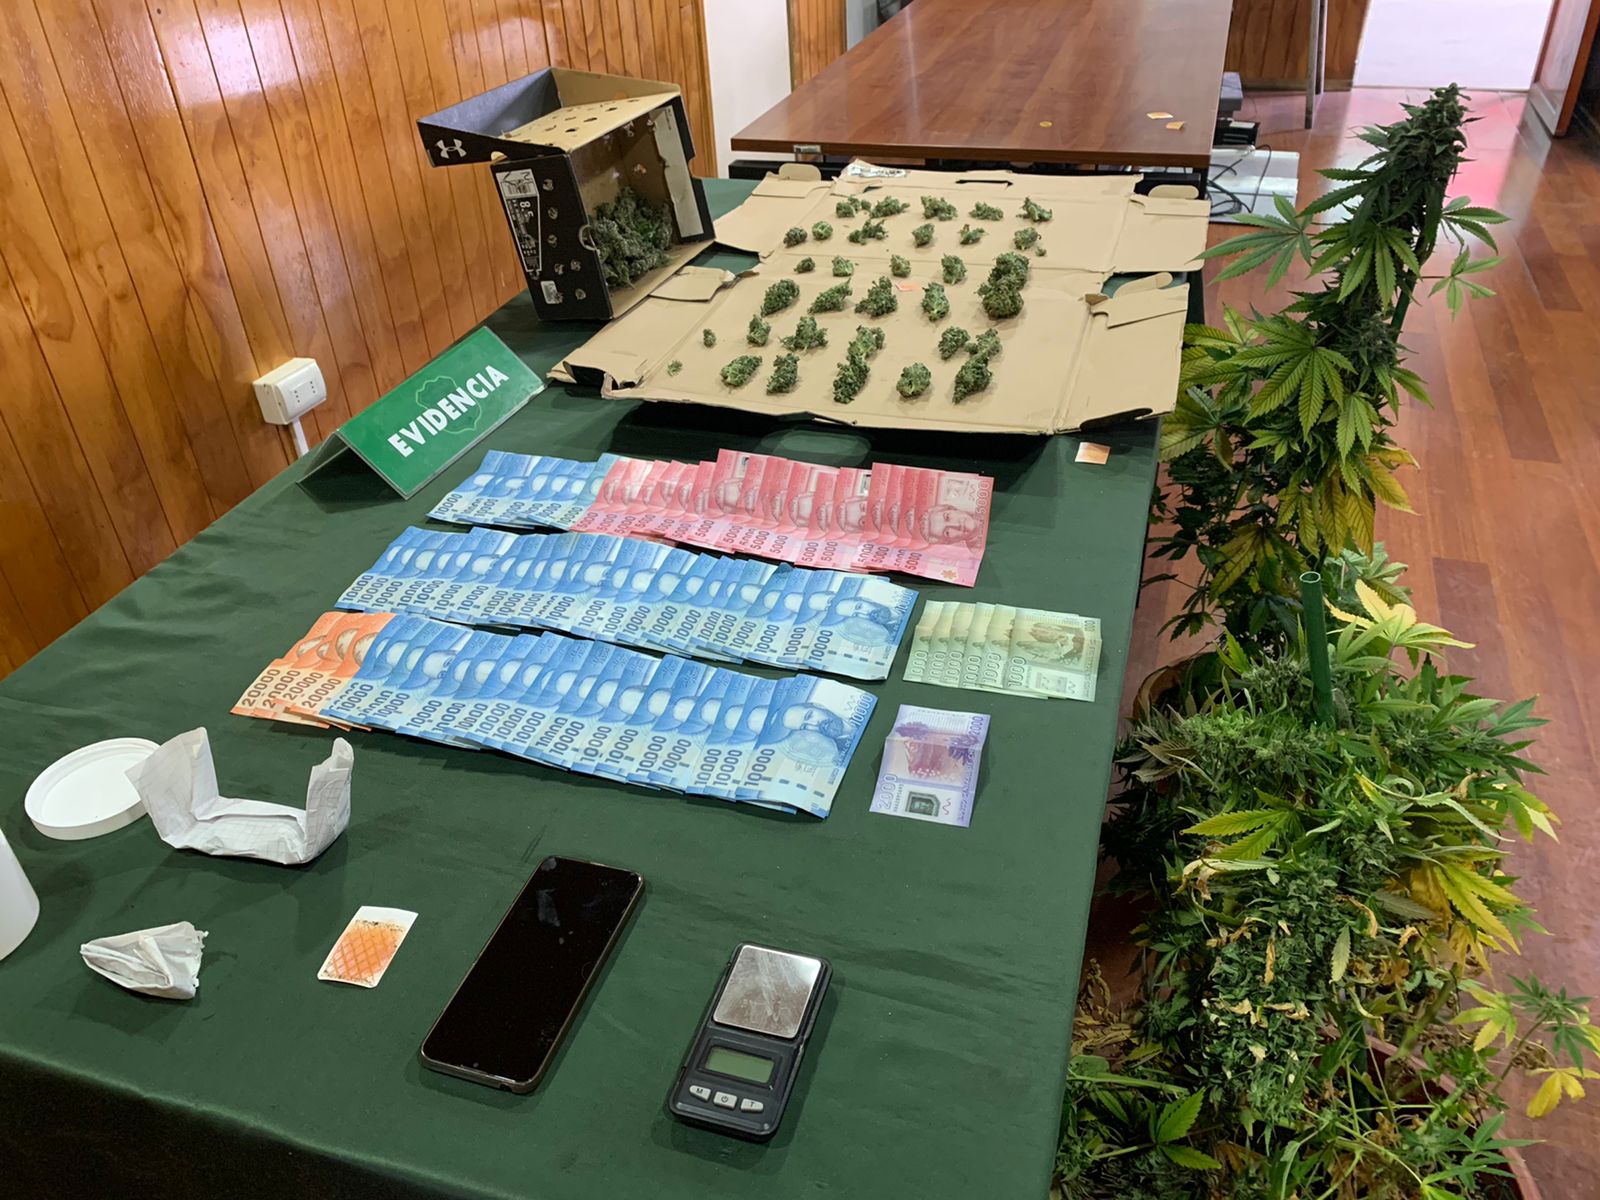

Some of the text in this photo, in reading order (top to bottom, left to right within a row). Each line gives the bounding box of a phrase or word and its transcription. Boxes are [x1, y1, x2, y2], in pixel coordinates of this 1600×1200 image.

[387, 364, 510, 458] EVIDENCIA
[751, 531, 770, 550] 5000
[770, 535, 788, 554] 5000
[802, 542, 818, 562] 5000
[821, 542, 838, 562] 5000
[343, 575, 374, 602] 10000
[357, 577, 388, 603] 10000
[372, 581, 403, 607] 10000
[397, 580, 426, 607] 10000
[413, 580, 444, 604] 10000
[434, 584, 462, 610] 10000
[457, 586, 488, 611] 10000
[496, 593, 525, 616] 10000
[518, 593, 544, 616] 10000
[545, 596, 575, 620] 10000
[578, 600, 606, 627] 10000
[602, 606, 627, 633] 10000
[622, 606, 650, 635] 10000
[648, 605, 678, 635] 10000
[673, 610, 701, 641] 10000
[713, 614, 737, 643] 10000
[729, 621, 757, 648] 10000
[753, 624, 780, 653] 10000
[783, 627, 806, 656] 10000
[808, 630, 833, 661] 10000
[242, 669, 280, 707] 20000
[262, 670, 301, 708] 20000
[282, 672, 323, 701] 20000
[301, 678, 342, 708] 20000
[336, 684, 374, 711] 10000
[372, 692, 410, 717] 10000
[406, 700, 442, 728] 10000
[454, 703, 488, 730] 10000
[474, 703, 511, 734] 10000
[491, 708, 527, 740] 10000
[511, 711, 546, 744] 10000
[549, 721, 585, 755] 10000
[579, 726, 612, 762] 10000
[604, 729, 639, 764] 10000
[635, 736, 667, 773] 10000
[657, 739, 692, 773] 10000
[694, 748, 722, 785] 10000
[712, 749, 742, 786] 10000
[743, 748, 776, 786] 10000
[877, 774, 898, 810] 2000
